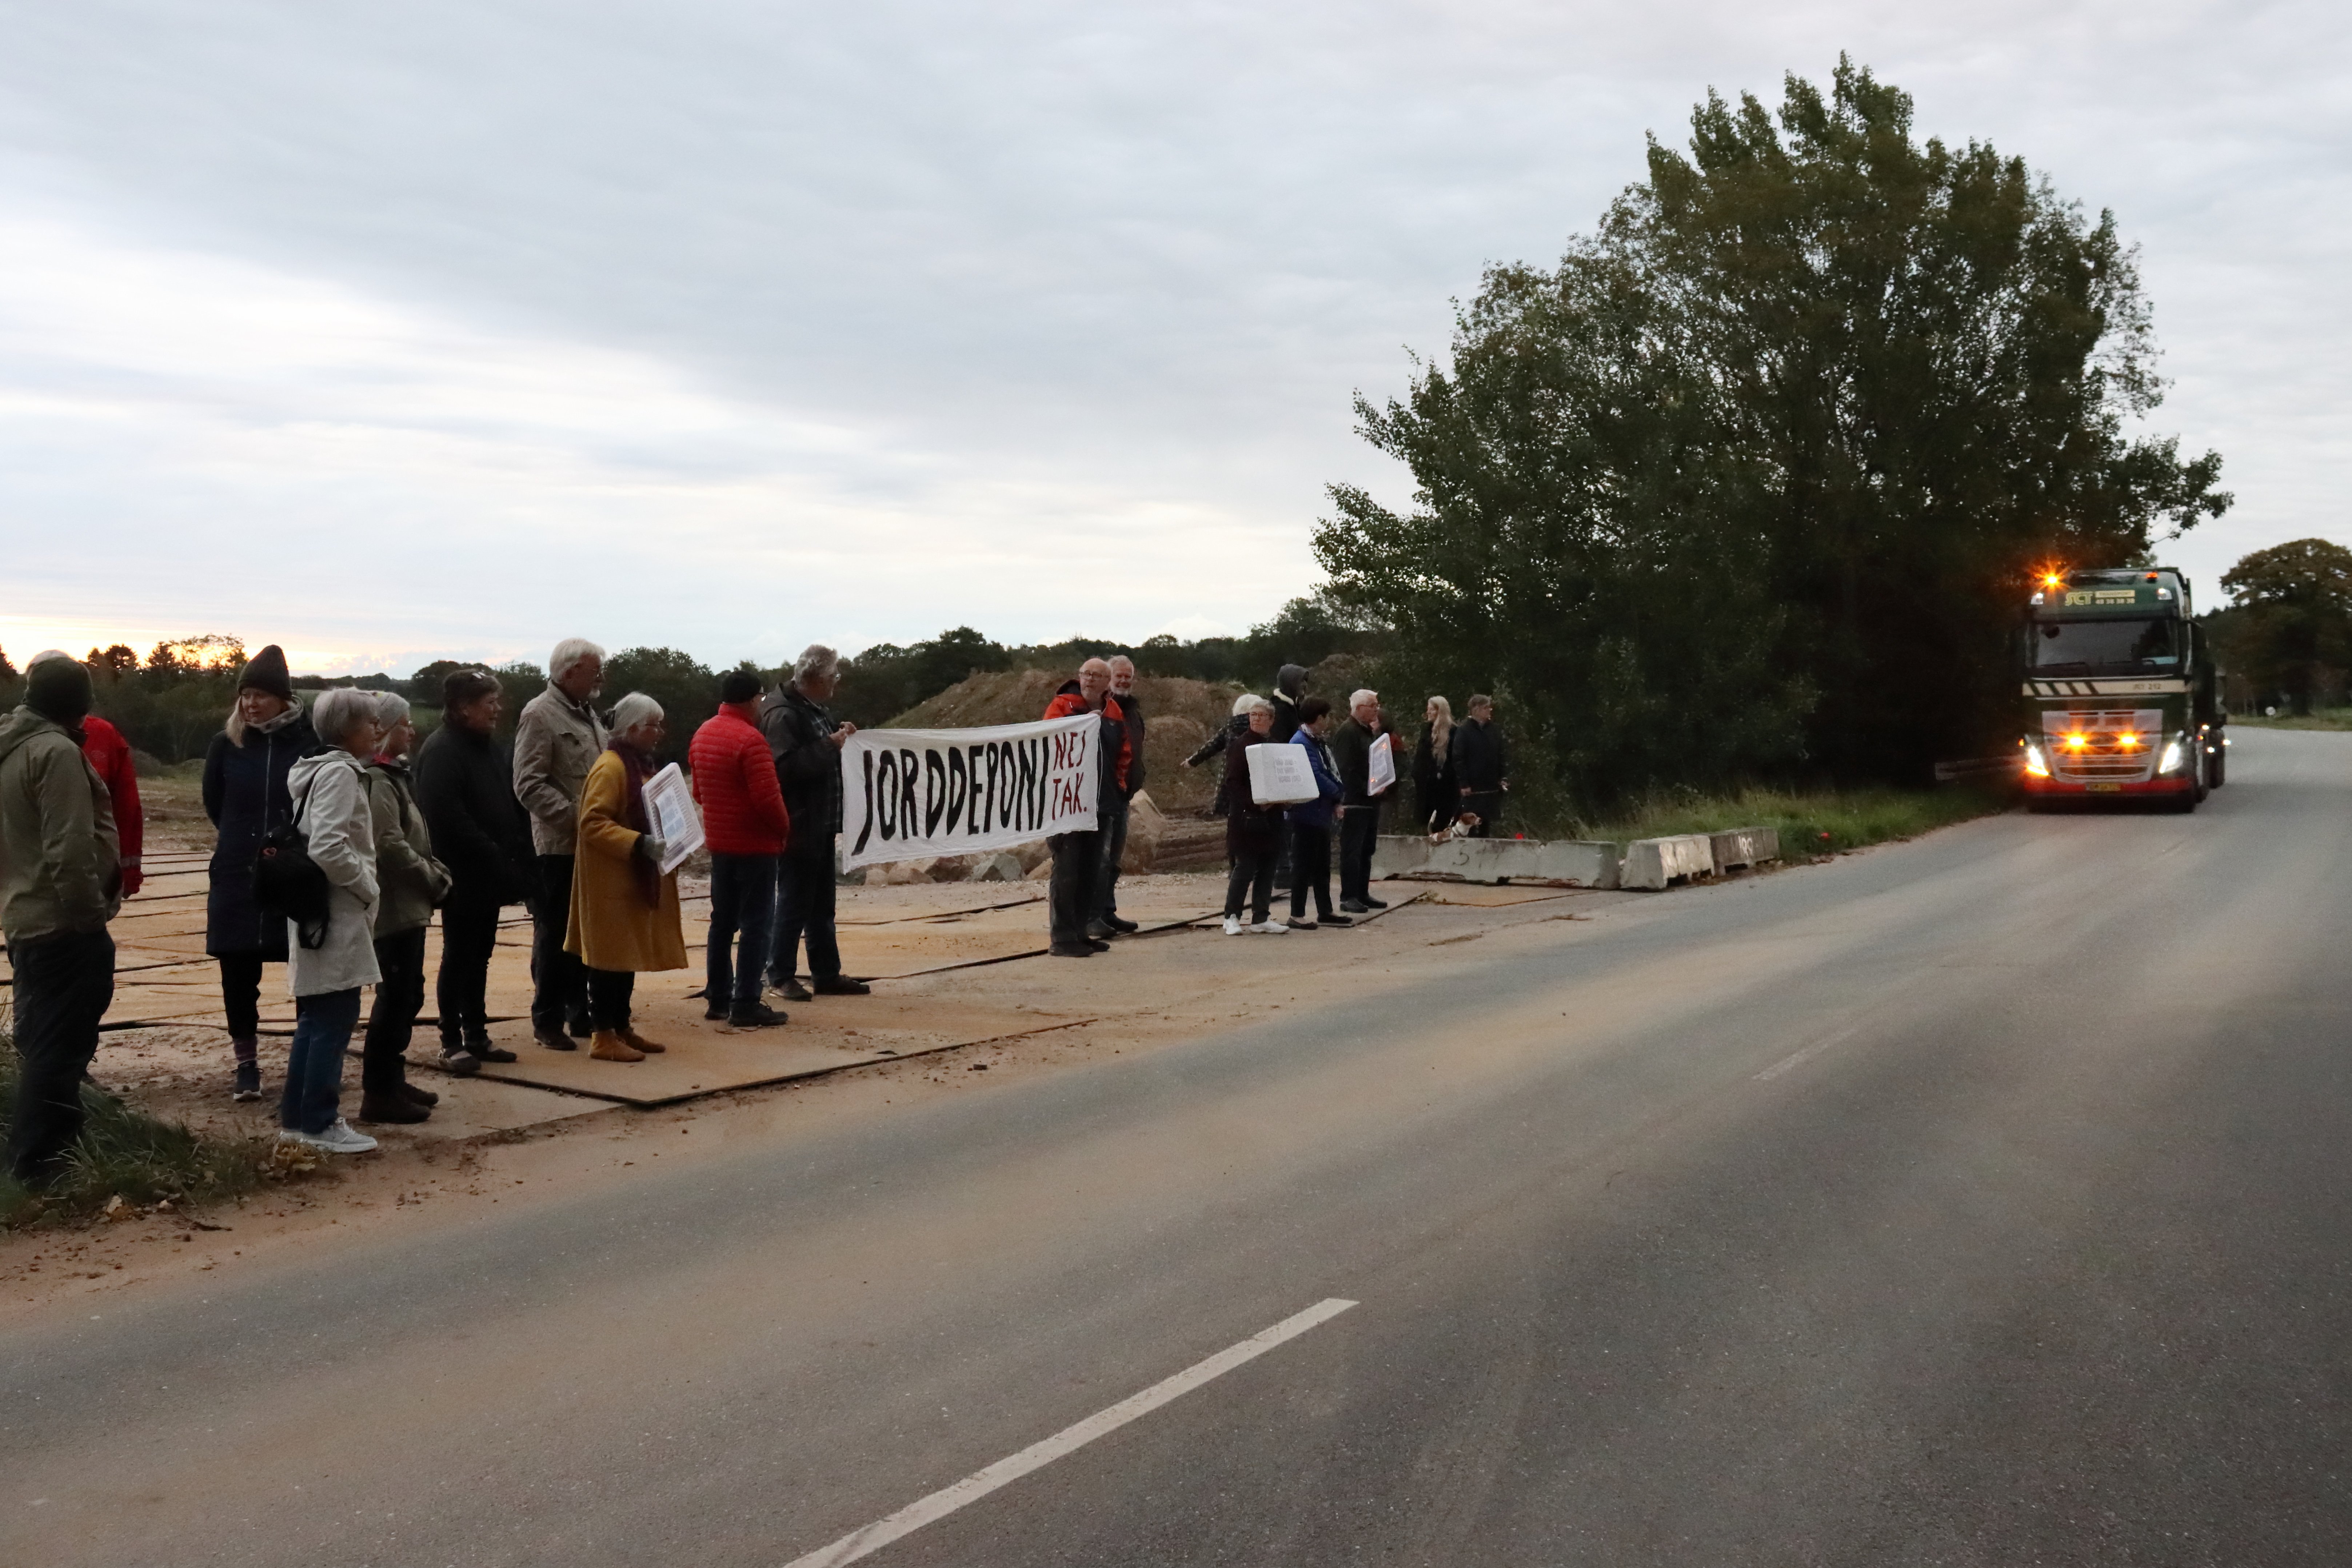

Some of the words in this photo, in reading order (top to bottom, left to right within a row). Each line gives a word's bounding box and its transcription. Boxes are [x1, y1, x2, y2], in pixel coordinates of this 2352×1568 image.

[2065, 591, 2093, 606] SCT
[1054, 730, 1086, 771] NEJ
[851, 736, 1049, 856] JORDDEPONI
[1052, 772, 1087, 820] TAK.
